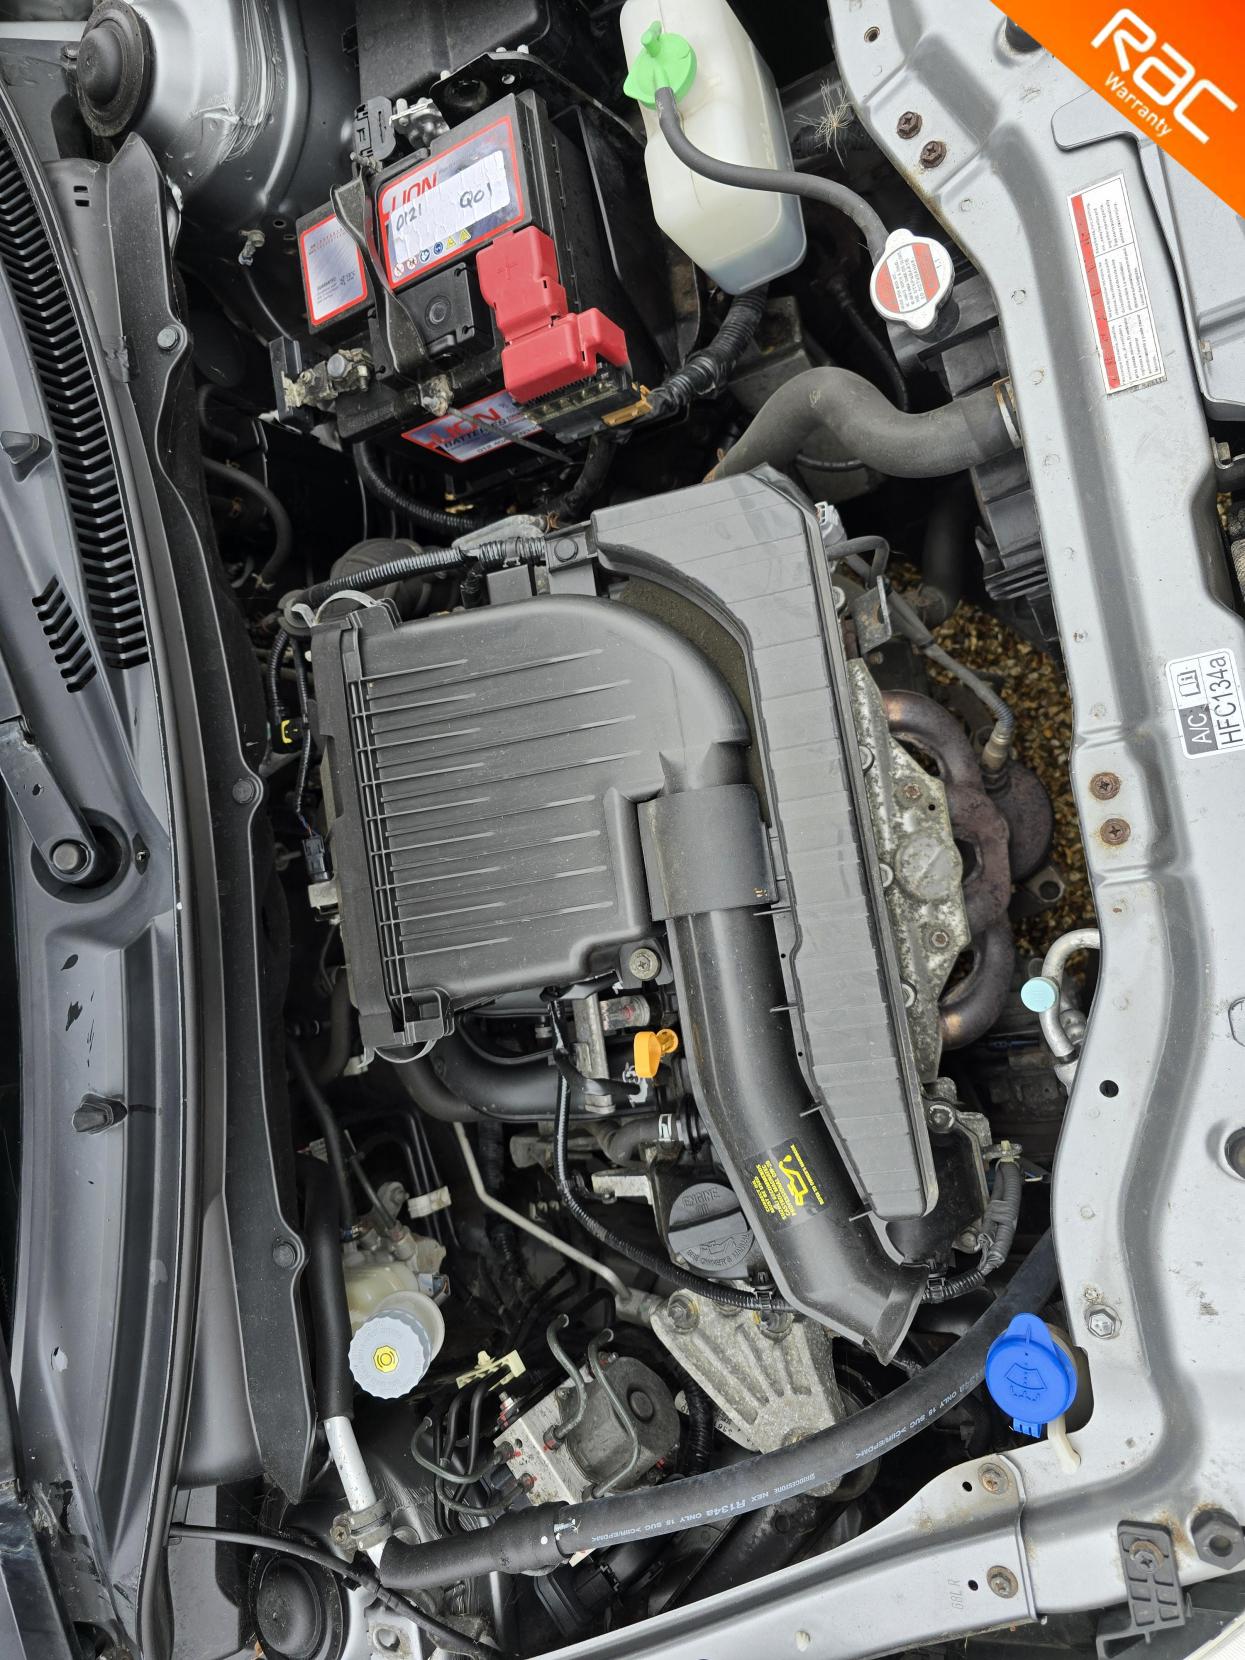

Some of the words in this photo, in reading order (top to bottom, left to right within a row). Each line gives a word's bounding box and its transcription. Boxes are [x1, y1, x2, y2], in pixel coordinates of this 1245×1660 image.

[1206, 656, 1244, 745] HFC134a
[1187, 713, 1214, 744] A/C
[681, 1187, 720, 1208] ENGINE
[706, 1499, 746, 1517] R134a
[644, 1522, 662, 1532] SUC
[679, 1512, 702, 1524] ONLY
